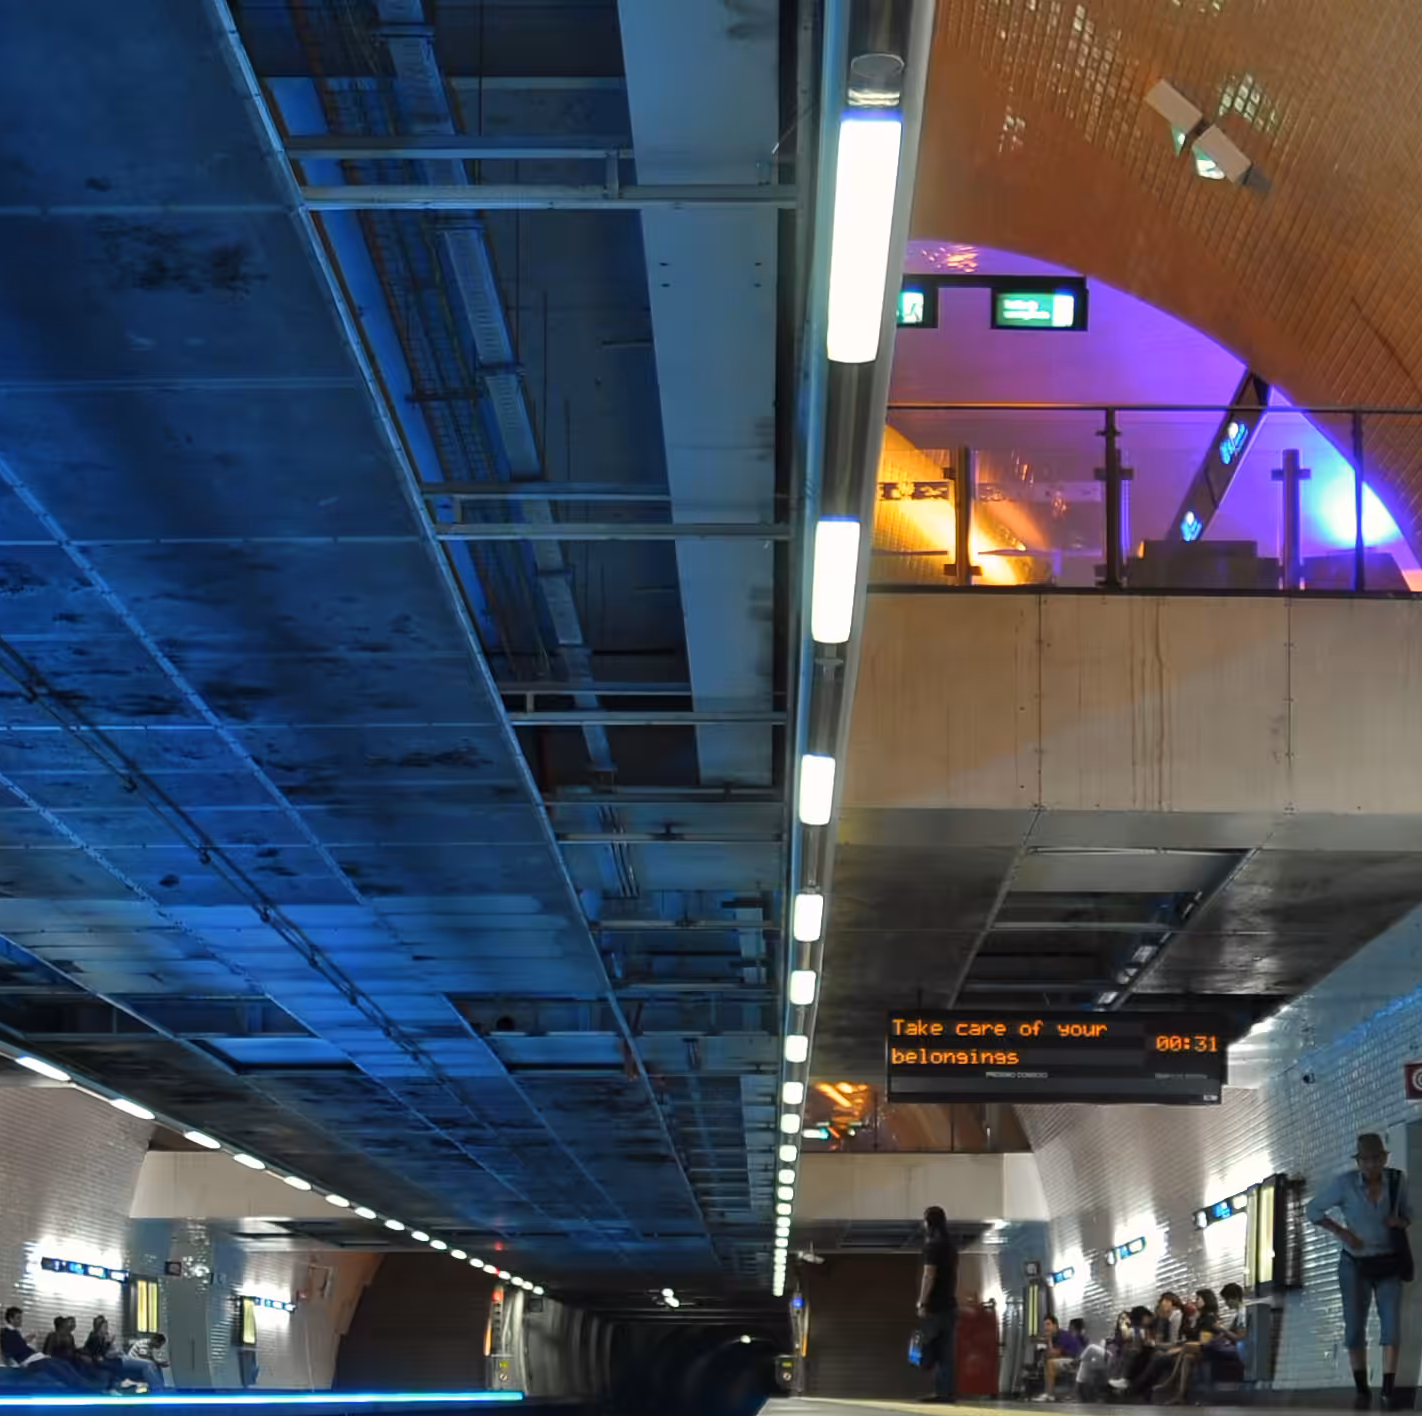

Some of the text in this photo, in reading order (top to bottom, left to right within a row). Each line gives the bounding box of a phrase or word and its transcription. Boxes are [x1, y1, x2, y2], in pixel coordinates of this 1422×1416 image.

[892, 1018, 1108, 1038] Take care of your
[1154, 1034, 1218, 1053] 00:31
[890, 1047, 1020, 1066] belongings
